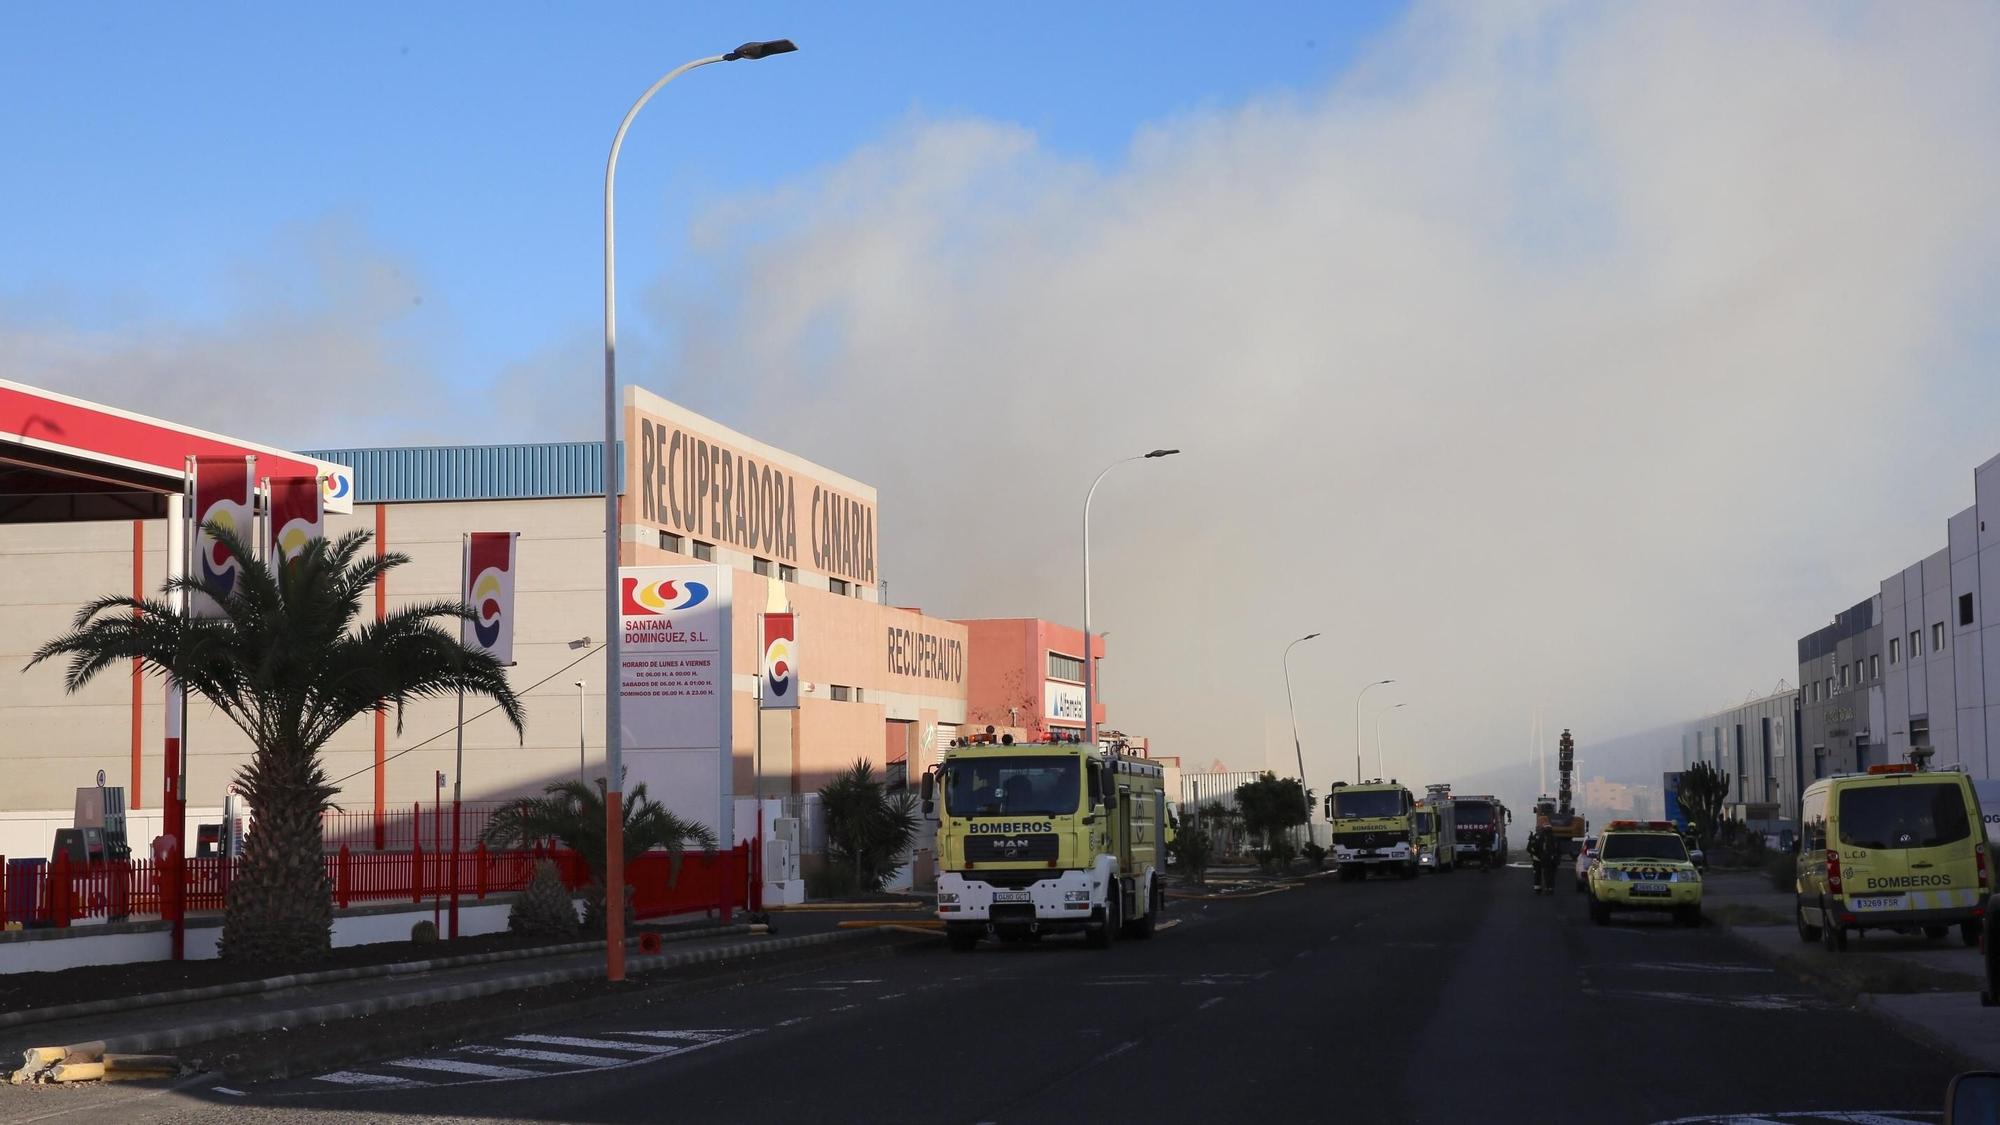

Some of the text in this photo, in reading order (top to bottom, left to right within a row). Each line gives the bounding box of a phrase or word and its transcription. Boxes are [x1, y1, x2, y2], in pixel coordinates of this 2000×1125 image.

[641, 417, 875, 584] RECUPERADORA CANARIA
[625, 620, 673, 631] SANTANA
[625, 632, 708, 644] DOMINGUEZ, S.L.
[887, 626, 962, 684] RECUPERAUTO
[969, 822, 1052, 834] BOMBEROS
[993, 840, 1029, 848] MAN
[1867, 874, 1951, 889] BOMBEROS
[1862, 899, 1882, 908] 3269
